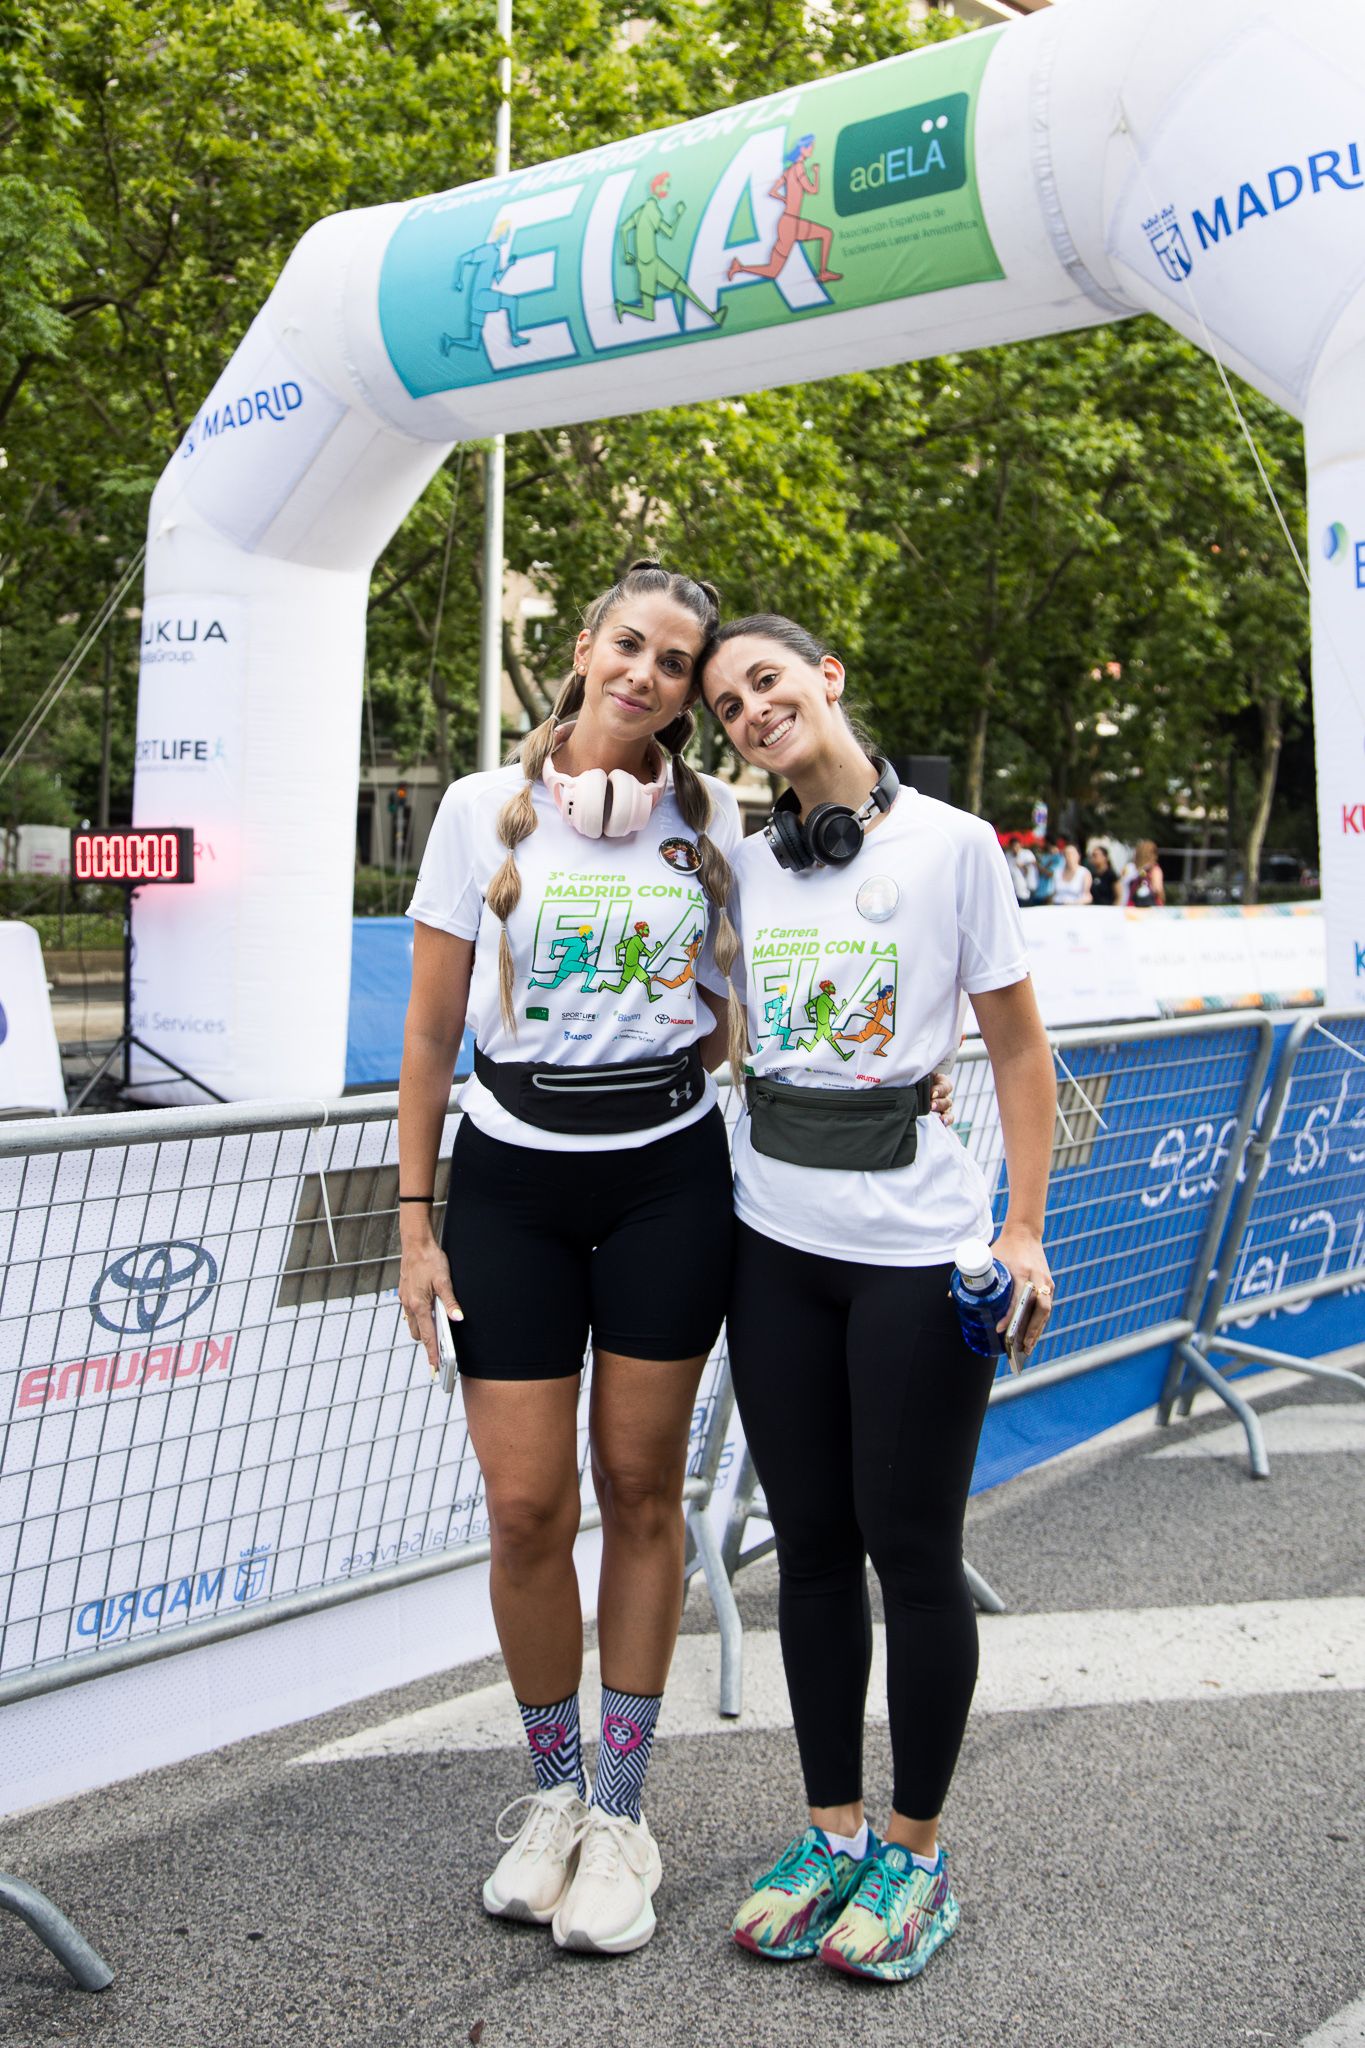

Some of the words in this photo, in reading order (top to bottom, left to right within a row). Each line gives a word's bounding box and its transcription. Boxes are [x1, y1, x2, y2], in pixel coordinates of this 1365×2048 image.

[659, 111, 747, 153] CON
[746, 94, 801, 128] LA
[849, 138, 947, 193] adELA
[482, 124, 835, 373] ELA
[202, 380, 304, 441] MADRID
[544, 885, 631, 898] MADRID
[637, 885, 682, 898] CON
[568, 873, 626, 882] Carrera
[752, 942, 820, 960] MADRID
[825, 940, 864, 955] CON
[870, 941, 898, 957] LA
[770, 927, 818, 939] Carrera
[752, 957, 899, 1039] ELA
[153, 1012, 227, 1034] Services
